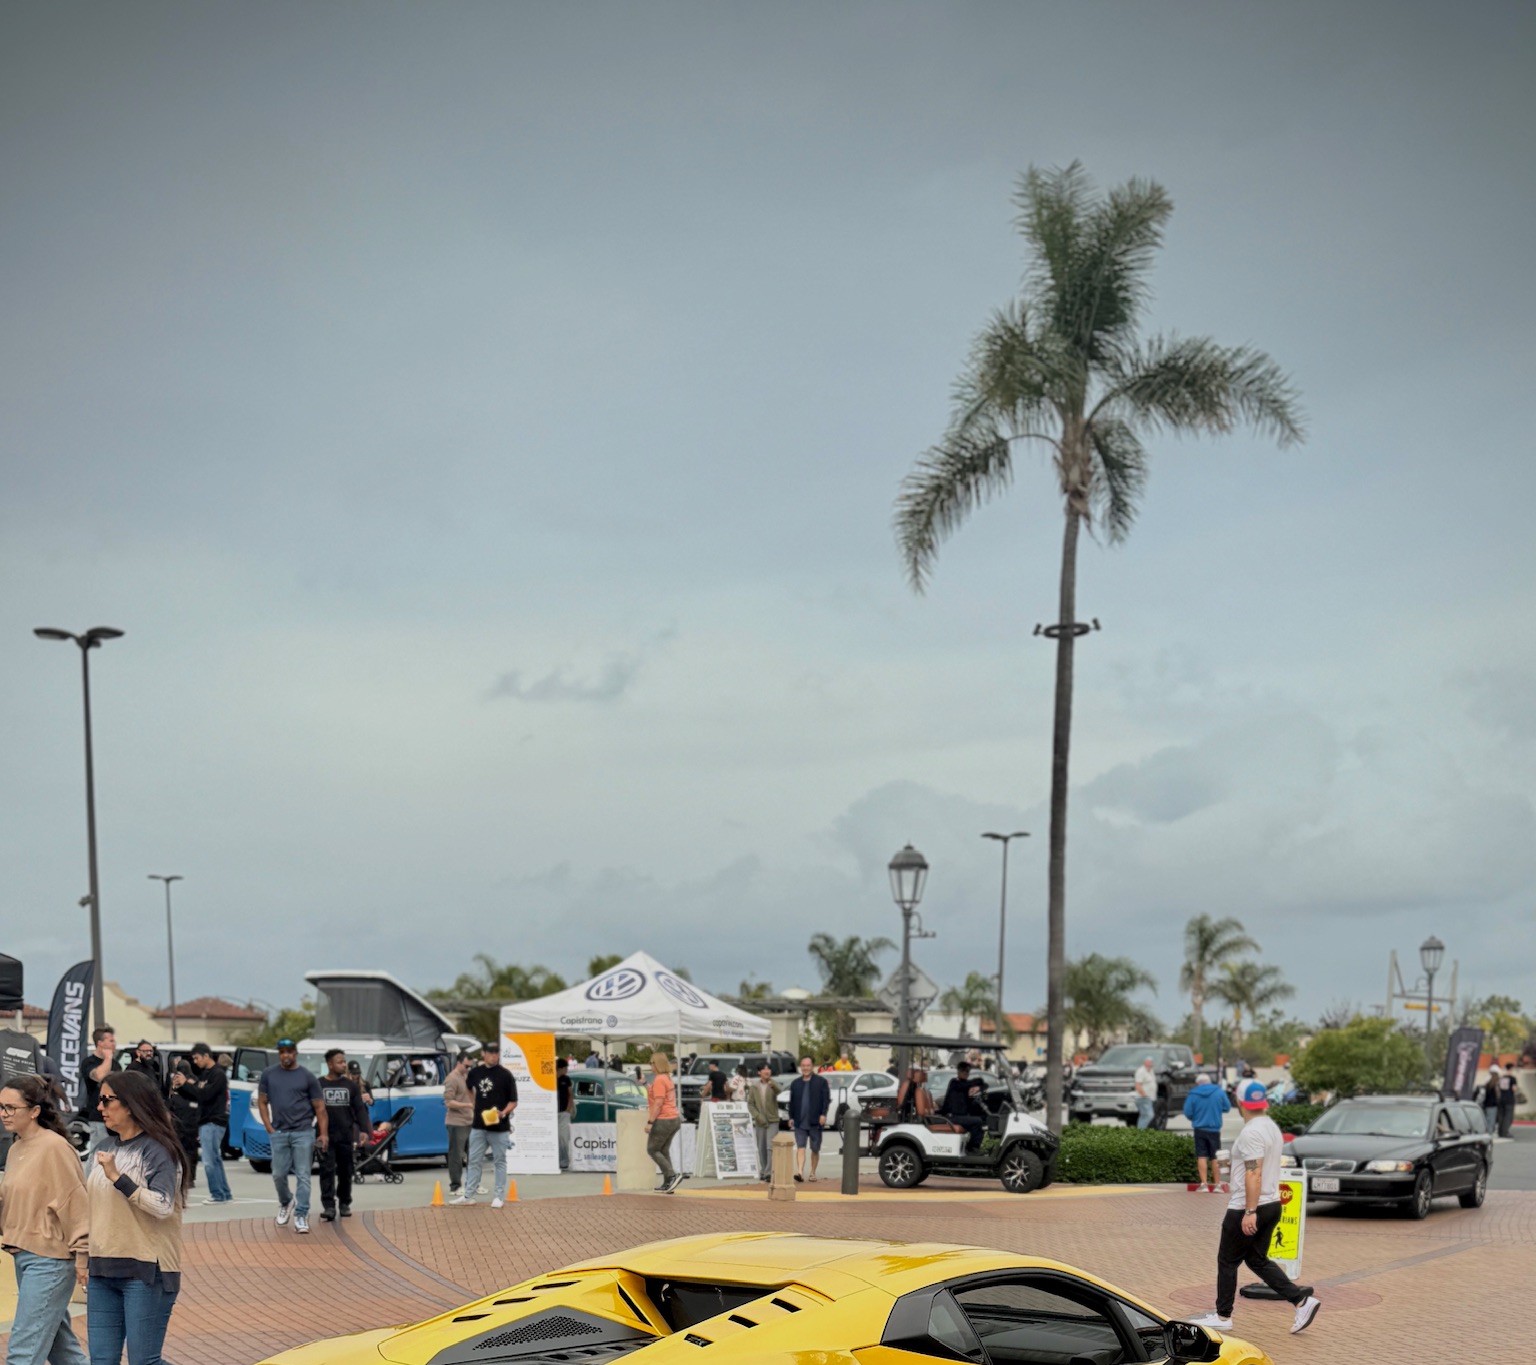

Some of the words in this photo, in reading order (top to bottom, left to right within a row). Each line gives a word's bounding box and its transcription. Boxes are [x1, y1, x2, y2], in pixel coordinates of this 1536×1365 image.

[560, 1016, 603, 1026] Capistrano
[59, 981, 85, 1112] PEACEVANS
[325, 1090, 347, 1101] CAT
[573, 1136, 617, 1151] Capistr
[1279, 1190, 1293, 1199] TOP
